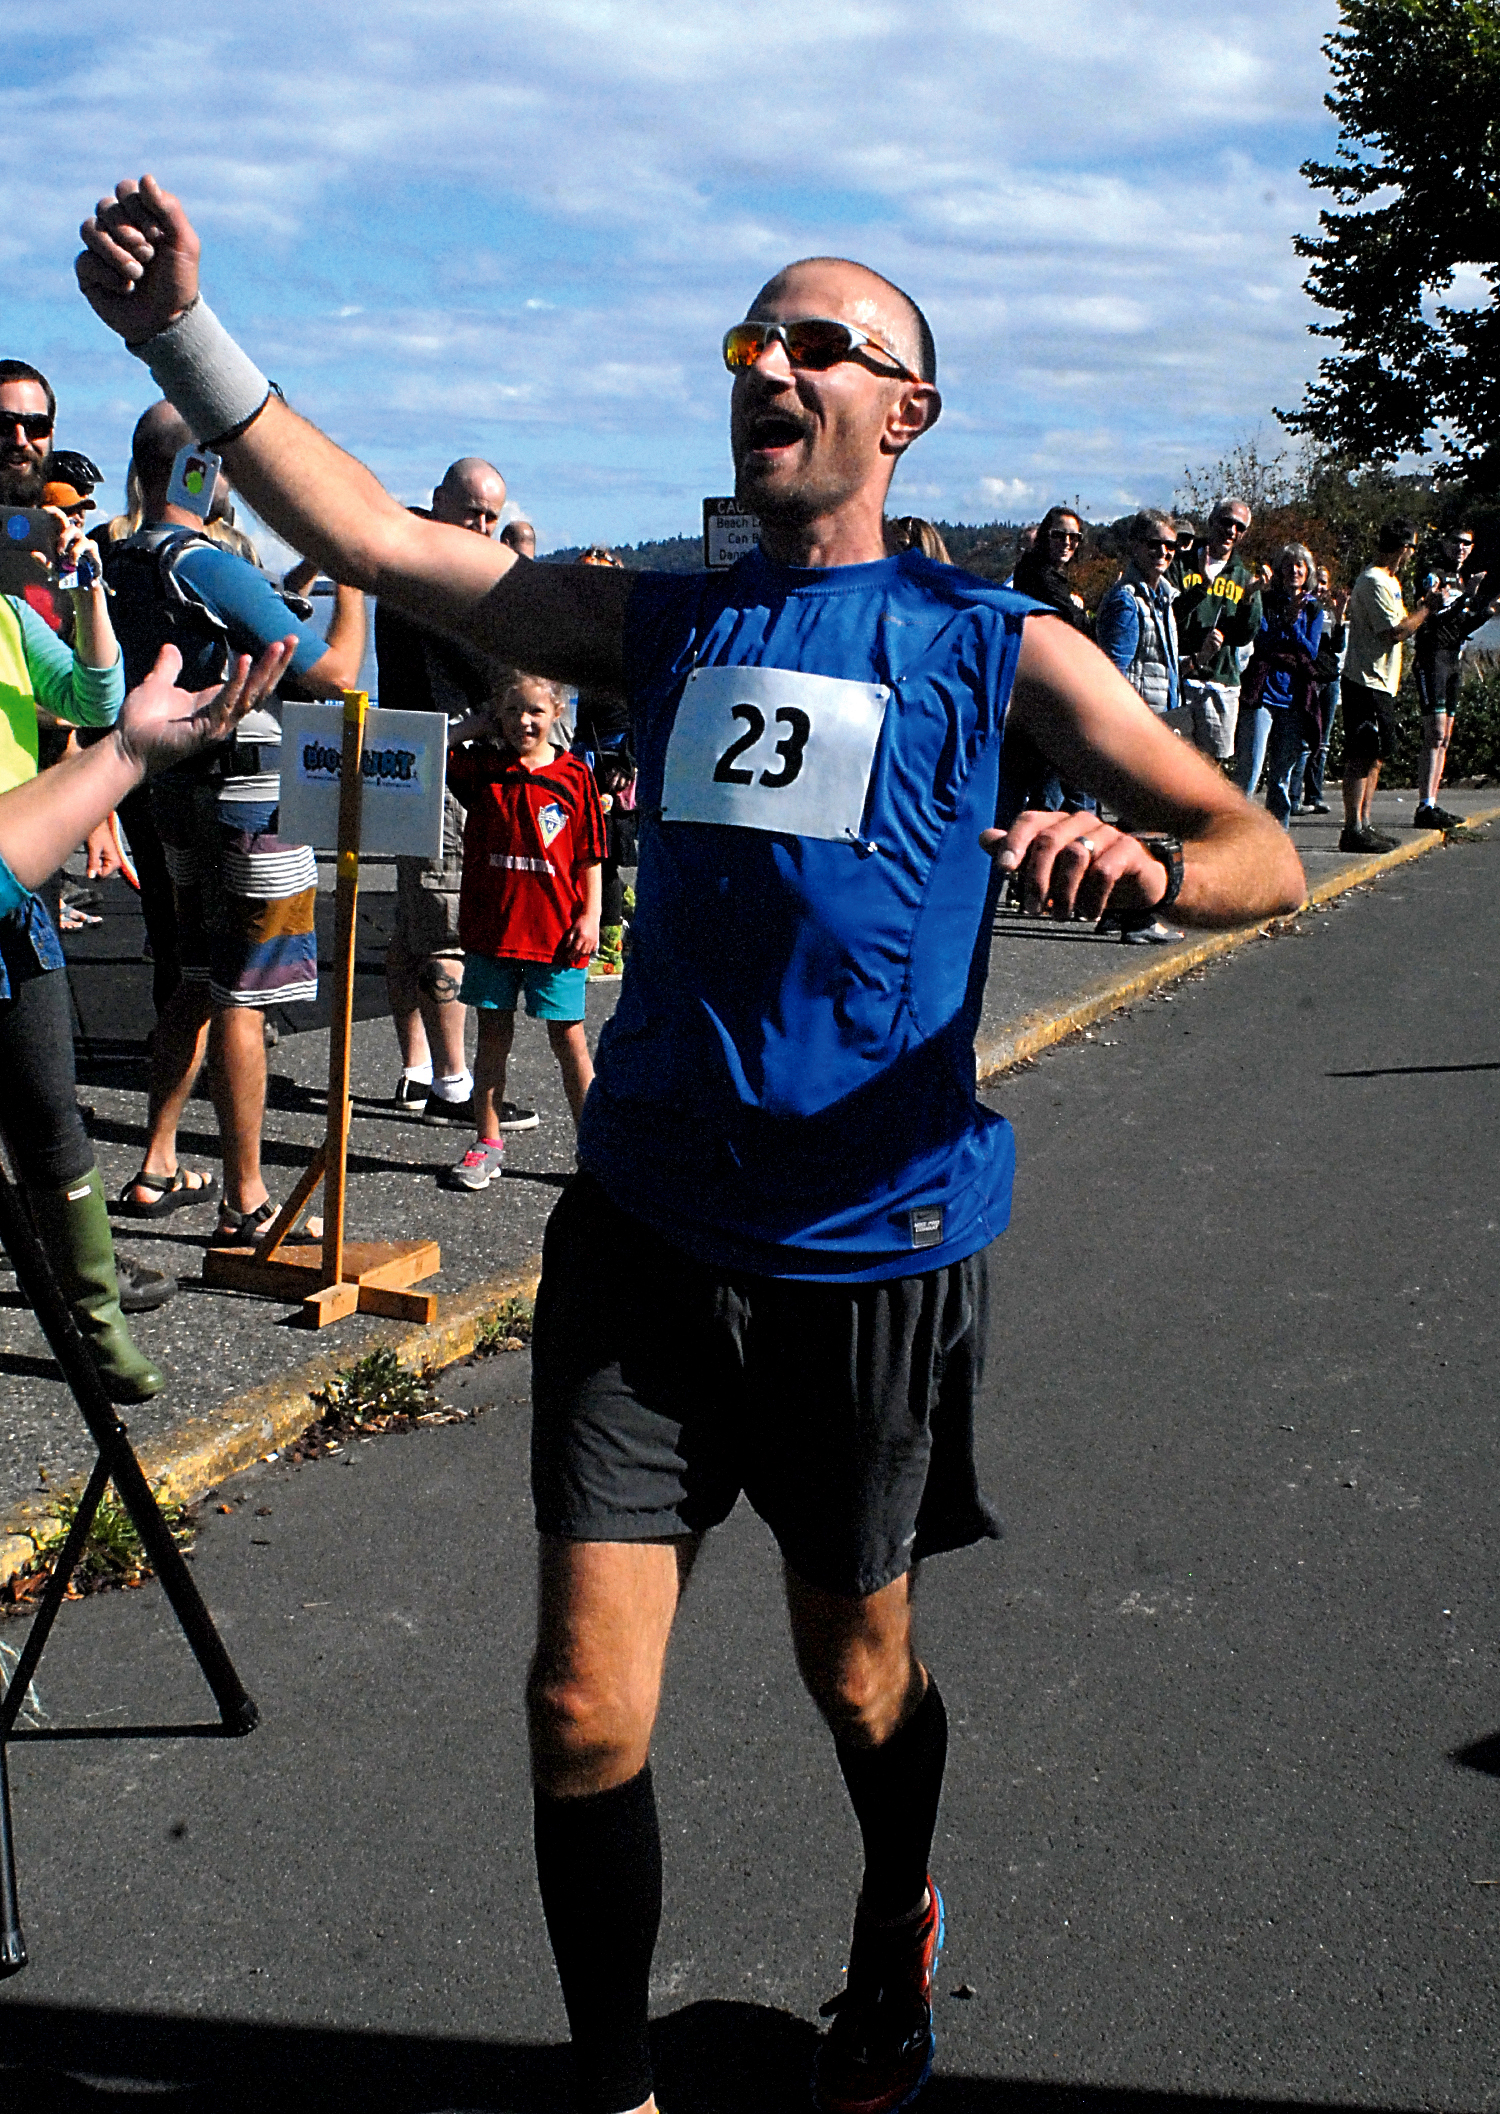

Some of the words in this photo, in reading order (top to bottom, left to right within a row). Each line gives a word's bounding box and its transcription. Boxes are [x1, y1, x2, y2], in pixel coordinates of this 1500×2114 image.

[716, 517, 748, 529] Beach
[728, 532, 748, 544] Can
[1182, 573, 1244, 604] ORGON
[713, 703, 811, 788] 23
